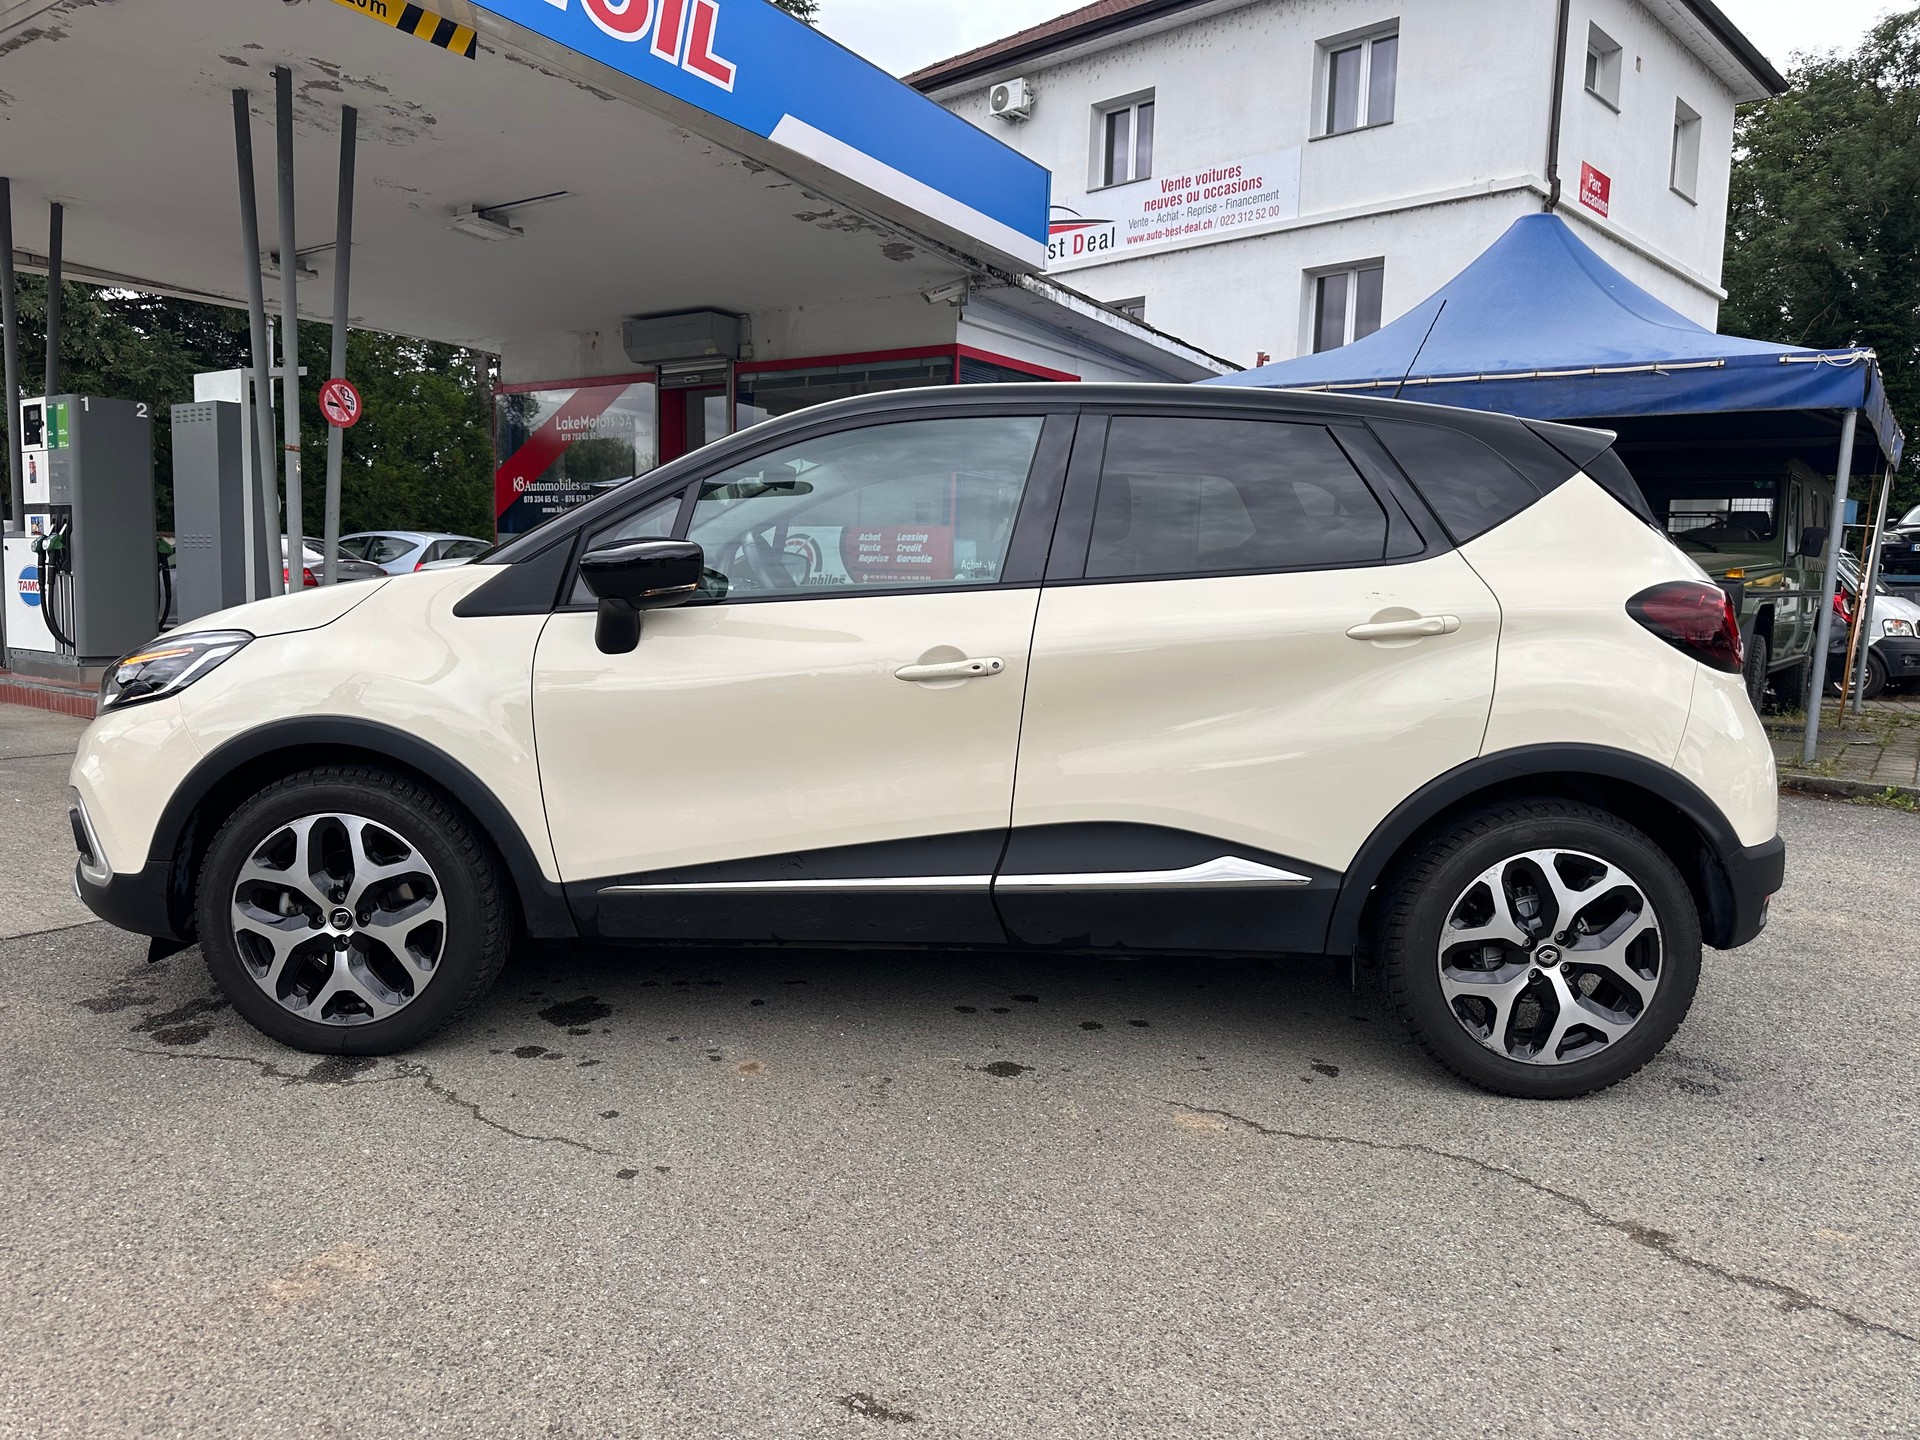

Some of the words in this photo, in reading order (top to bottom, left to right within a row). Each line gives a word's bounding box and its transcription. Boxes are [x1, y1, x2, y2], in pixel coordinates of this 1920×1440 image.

[543, 0, 737, 93] OIL
[1161, 176, 1191, 193] Vente
[1196, 165, 1242, 186] voitures
[1588, 173, 1602, 194] Parc
[1144, 194, 1183, 212] neuves
[1186, 191, 1200, 203] ou
[1204, 176, 1263, 200] occasions
[1128, 217, 1149, 229] Vente
[1156, 210, 1179, 224] Achat
[1186, 203, 1217, 218] Reprise
[1225, 189, 1280, 210] Financement
[1126, 218, 1213, 245] www.auto-best-deal.ch
[1219, 215, 1235, 227] 022
[1237, 211, 1253, 224] 312
[1255, 207, 1266, 220] 52
[1268, 205, 1280, 217] 00
[1048, 237, 1065, 259] st
[1073, 227, 1115, 255] Deal
[81, 396, 89, 411] 1
[136, 402, 148, 418] 2
[556, 414, 615, 430] LakeMotors
[619, 413, 632, 428] SA
[859, 533, 881, 541] Achat
[897, 532, 928, 543] Leasing
[859, 544, 881, 552] Vente
[858, 554, 889, 564] Reprise
[896, 554, 932, 563] Garantie
[961, 559, 982, 570] Achat
[19, 581, 41, 592] TAMO
